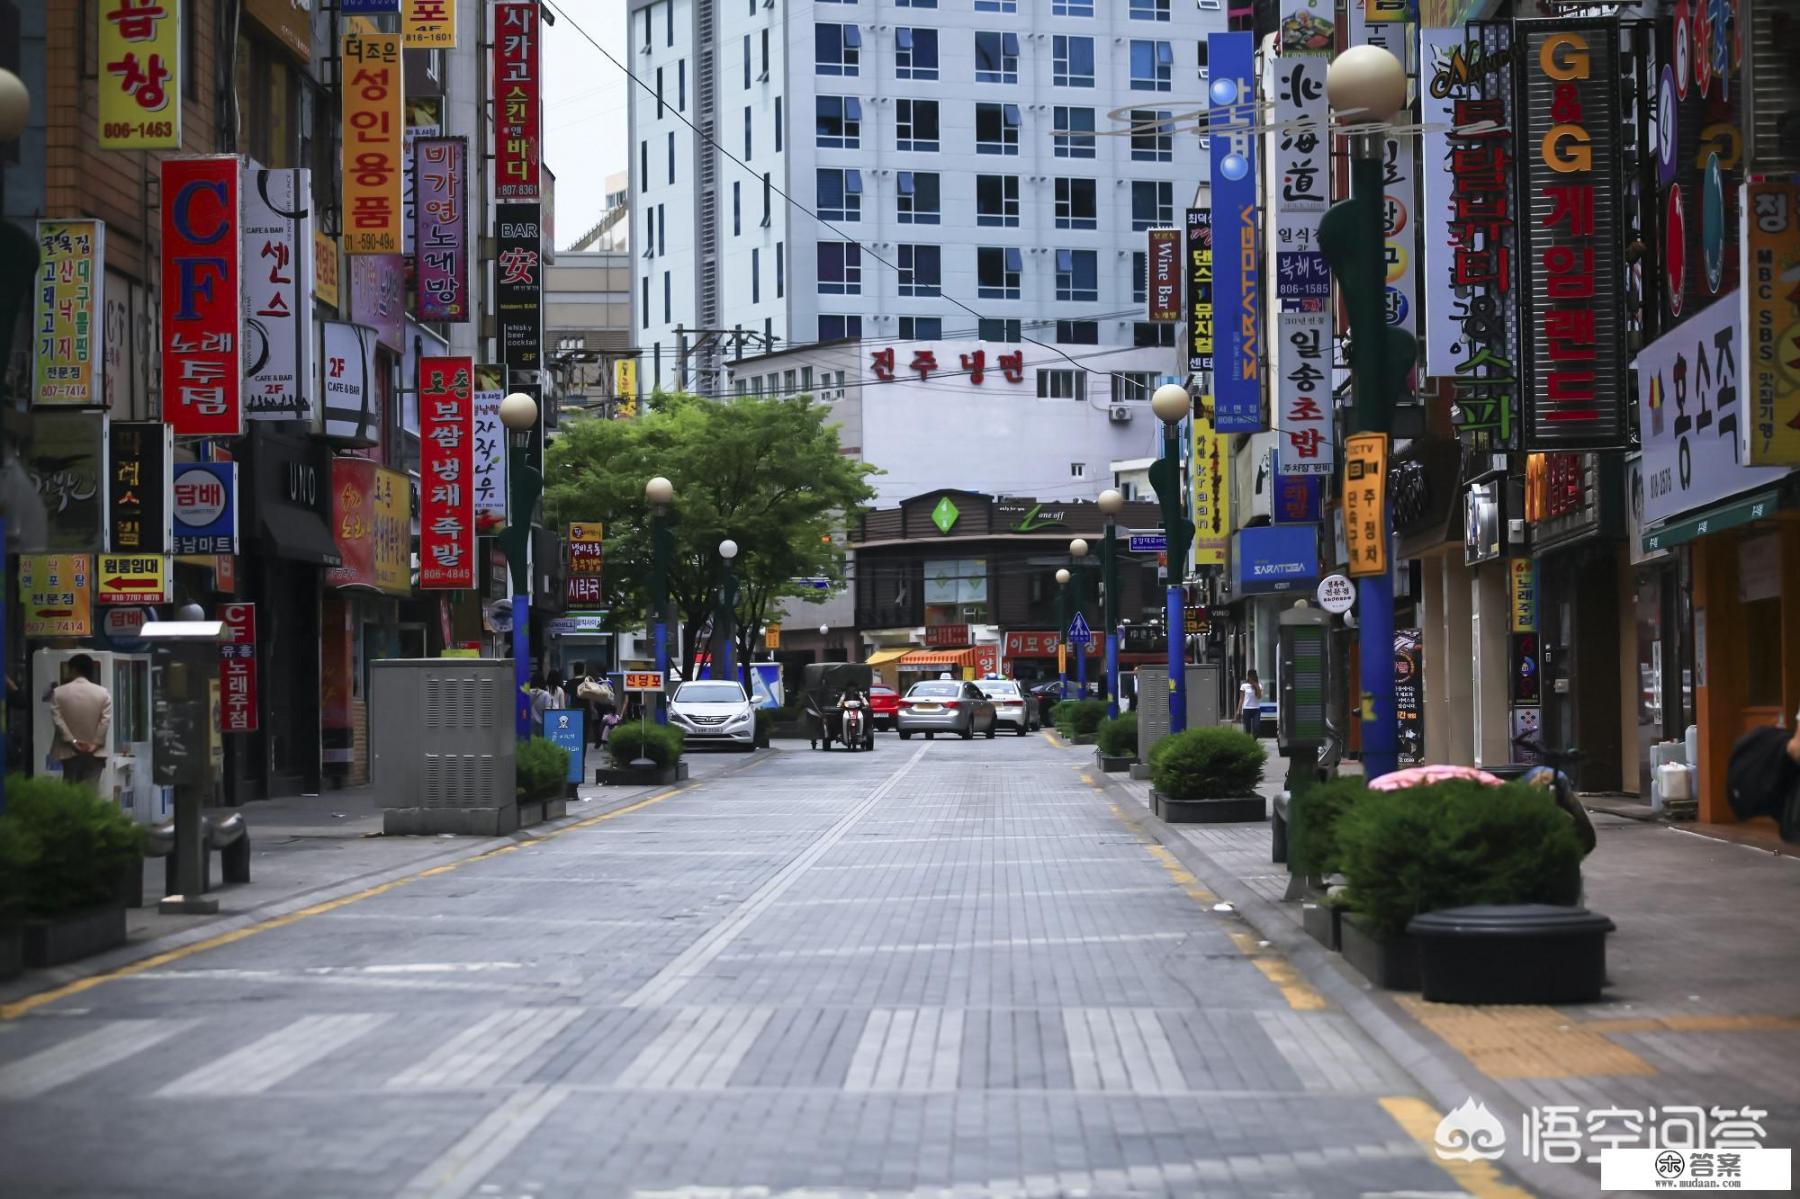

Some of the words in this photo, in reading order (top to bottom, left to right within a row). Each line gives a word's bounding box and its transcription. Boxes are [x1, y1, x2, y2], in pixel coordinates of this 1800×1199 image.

[503, 7, 532, 81] 시카고
[350, 69, 394, 228] 성인용품
[1281, 63, 1324, 202] 北海道
[501, 224, 538, 238] BAR
[500, 248, 538, 284] 安
[1158, 242, 1173, 280] Wine
[1193, 250, 1212, 283] 댄스
[1280, 255, 1328, 281] 북해도
[1757, 250, 1773, 300] MBC
[260, 240, 292, 317] 센스
[1280, 284, 1329, 294] 806-1585
[42, 261, 56, 361] 고래고기
[58, 260, 74, 361] 산낙지
[1158, 285, 1173, 309] Bar
[1542, 185, 1600, 422] 게임랜드
[1194, 304, 1213, 353] 뮤지컬
[1758, 310, 1773, 360] SBS
[329, 357, 345, 377] 2F
[870, 348, 1024, 384] 전주냉면
[265, 385, 284, 394] 2F
[327, 381, 344, 392] CAFE
[350, 385, 360, 396] BAR
[475, 420, 496, 501] 자작나무
[1349, 444, 1374, 455] CCTV
[175, 484, 220, 507] 담배
[290, 460, 316, 506] UNO
[1053, 511, 1065, 520] off
[105, 559, 158, 573] 원룸임대
[32, 593, 75, 605] 전문점
[569, 578, 600, 598] 시락국
[110, 611, 143, 626] 담배
[626, 674, 661, 687] 전당포
